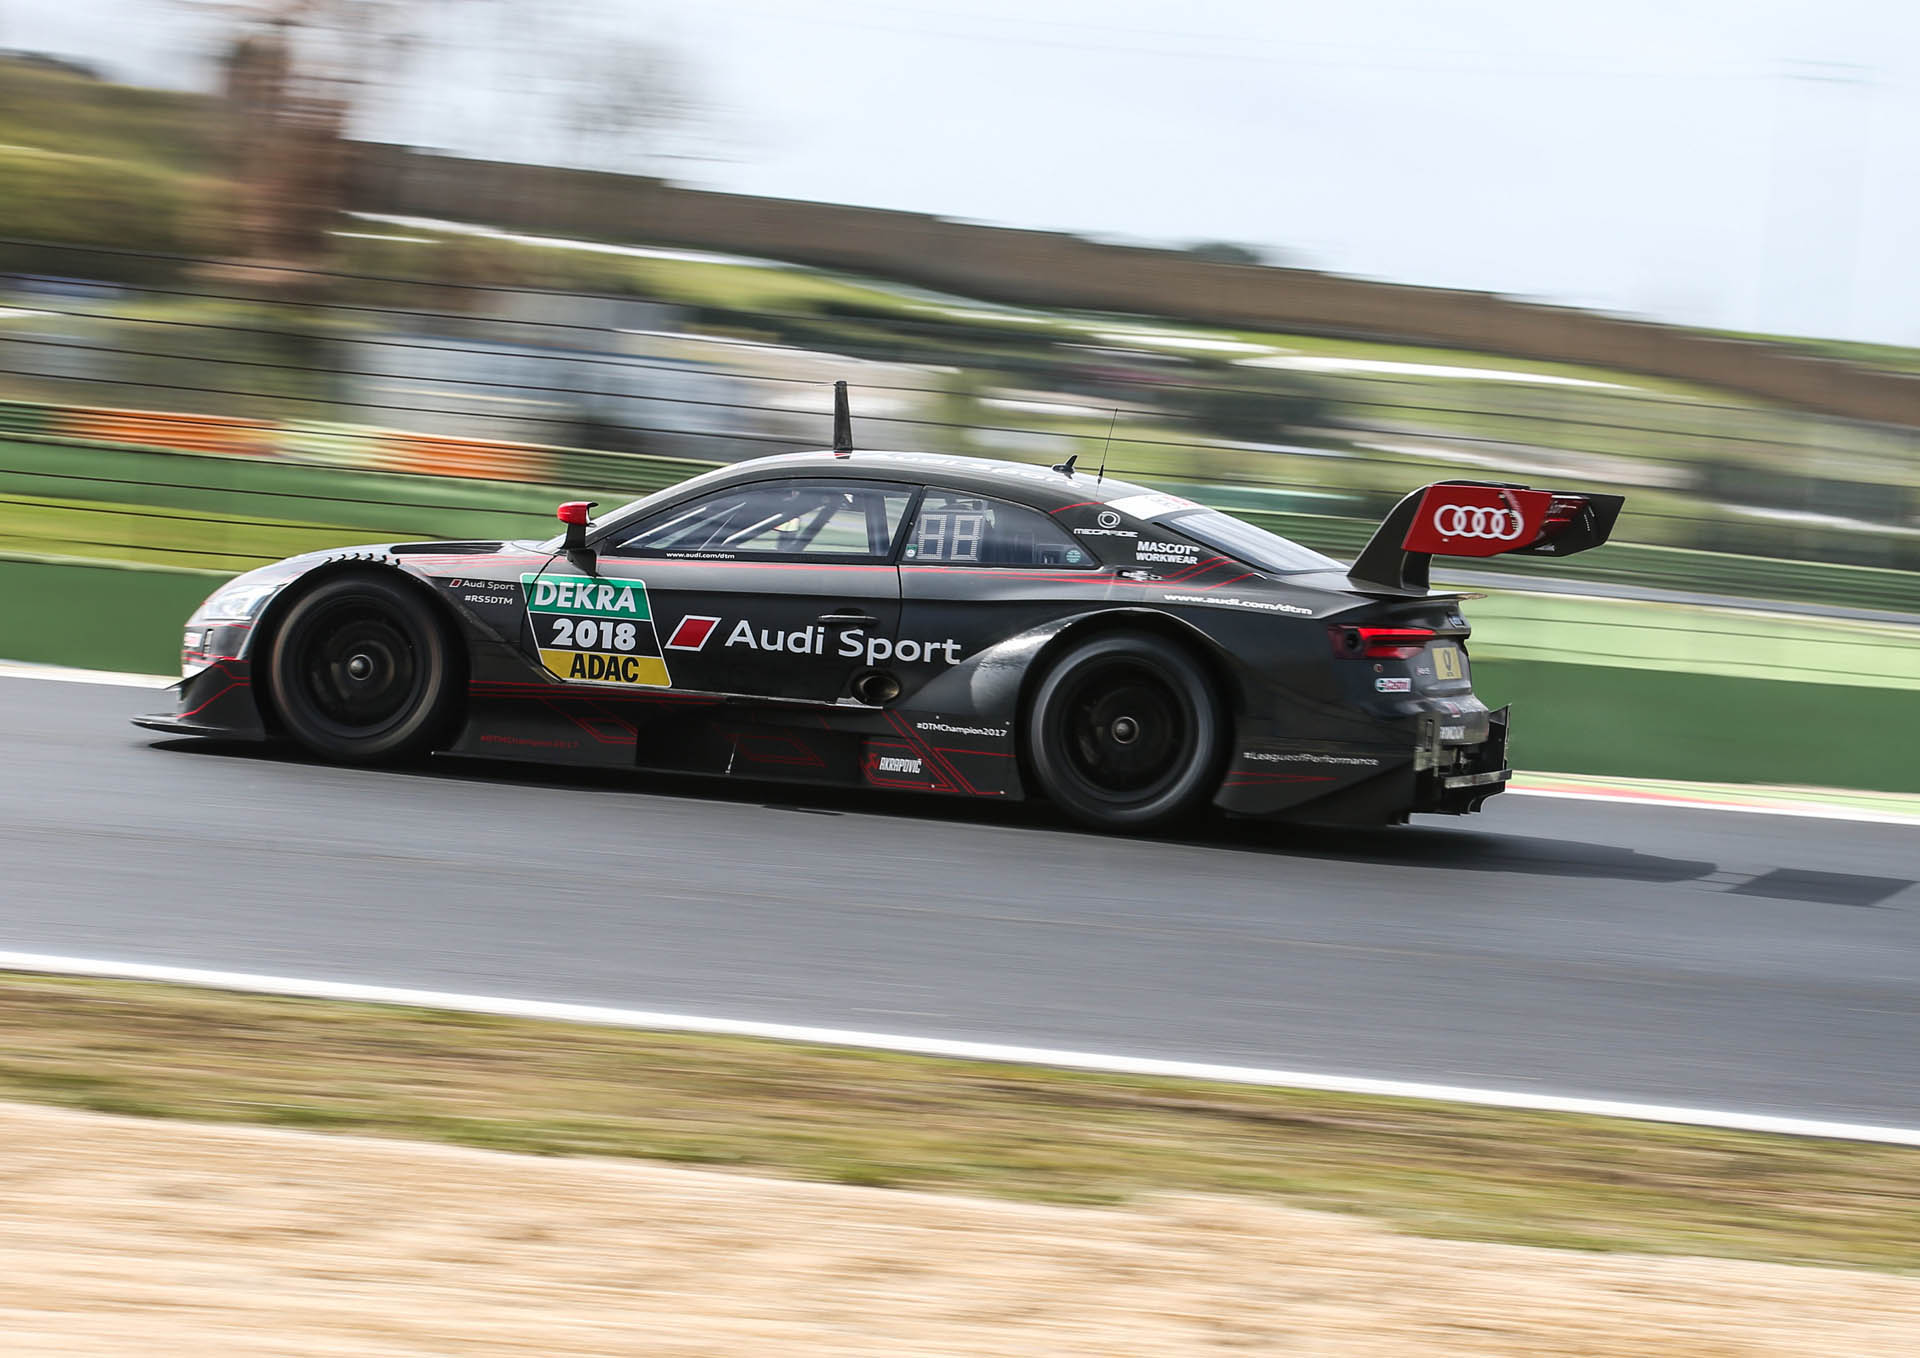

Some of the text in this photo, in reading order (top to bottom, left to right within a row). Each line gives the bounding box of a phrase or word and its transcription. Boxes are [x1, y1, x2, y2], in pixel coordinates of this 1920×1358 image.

[666, 552, 736, 560] www.audi.com/dtm
[1135, 552, 1198, 565] WORKWEAR
[462, 580, 515, 591] Audi Sport
[534, 579, 637, 613] DEKRA
[1164, 594, 1313, 615] www.audi.com/dtm
[550, 617, 637, 651] 2018
[724, 619, 962, 666] Audi Sport
[569, 653, 639, 682] ADAC
[917, 722, 1008, 737] #DTMChampion2017
